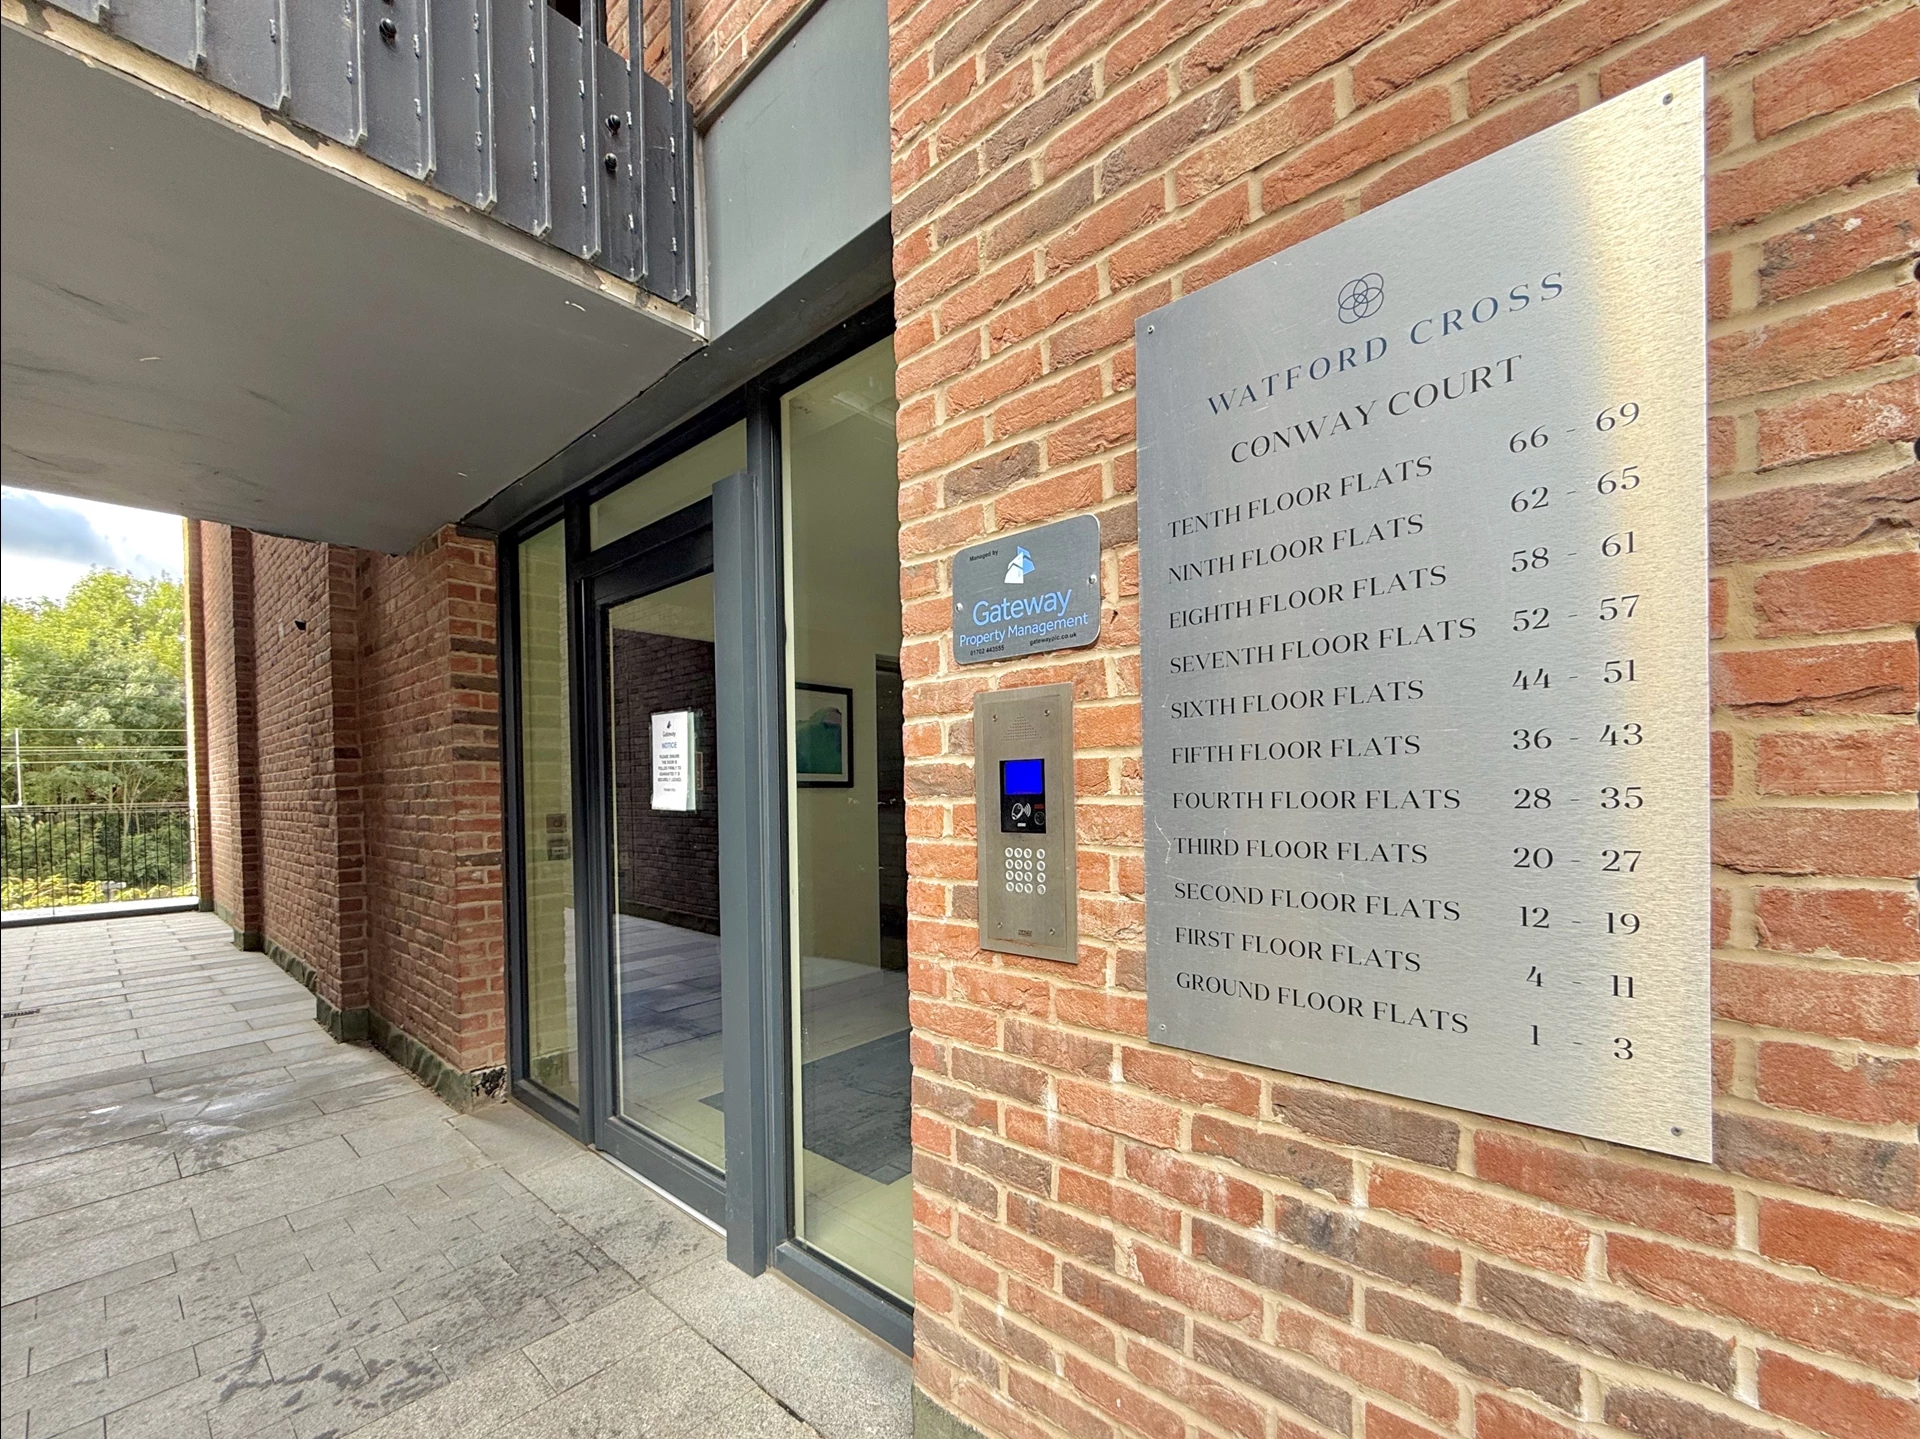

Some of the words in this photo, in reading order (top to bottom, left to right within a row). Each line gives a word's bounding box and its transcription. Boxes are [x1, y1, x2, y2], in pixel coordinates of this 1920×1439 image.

[1208, 337, 1388, 416] WATFORD
[1410, 272, 1563, 345] CROSS
[1231, 400, 1378, 464] CONWAY
[1389, 355, 1523, 416] COURT
[1168, 504, 1241, 539] TENTH
[1248, 482, 1333, 520] FLOOR
[1341, 456, 1433, 497] FLATS
[1510, 425, 1549, 454] 66
[1596, 402, 1640, 432] 69
[969, 551, 991, 562] Managed
[1169, 554, 1235, 584] NINTH
[1241, 536, 1325, 570] FLOOR
[1332, 514, 1424, 551] FLATS
[1510, 487, 1550, 513] 62
[1597, 465, 1641, 496] 65
[972, 589, 1072, 626] Gateway
[1169, 599, 1253, 630] EIGHTH
[1259, 584, 1345, 615] FLOOR
[1353, 566, 1447, 600] FLATS
[1511, 547, 1550, 573] 58
[1602, 531, 1638, 558] 61
[960, 629, 1006, 647] Property
[1008, 612, 1088, 638] Management
[1170, 644, 1275, 674] SEVENTH
[1281, 633, 1370, 662] FLOOR
[1379, 618, 1477, 649] FLATS
[1512, 608, 1550, 632] 52
[1599, 595, 1641, 622] 57
[1170, 697, 1236, 720] SIXTH
[1242, 690, 1326, 714] FLOOR
[1333, 680, 1425, 707] FLATS
[1512, 668, 1552, 691] 44
[1603, 659, 1638, 685] 51
[1173, 745, 1234, 765] FIFTH
[1240, 741, 1323, 762] FLOOR
[1330, 735, 1421, 758] FLATS
[1512, 728, 1553, 751] 36
[1599, 723, 1644, 747] 43
[1173, 791, 1264, 810] FOURTH
[1270, 790, 1358, 810] FLOOR
[1366, 789, 1461, 810] FLATS
[1513, 788, 1552, 810] 28
[1600, 787, 1644, 810] 35
[1173, 837, 1240, 857] THIRD
[1246, 840, 1330, 861] FLOOR
[1337, 842, 1428, 865] FLATS
[1512, 847, 1554, 870] 20
[1601, 850, 1643, 873] 27
[1174, 882, 1264, 906] SECOND
[1270, 888, 1359, 914] FLOOR
[1366, 895, 1461, 922] FLATS
[1518, 906, 1550, 929] 12
[1605, 912, 1641, 936] 19
[1175, 927, 1236, 950] FIRST
[1241, 934, 1324, 962] FLOOR
[1331, 944, 1421, 973] FLATS
[1526, 966, 1545, 988] 4
[1610, 975, 1635, 999] 11
[1176, 972, 1271, 1002] GROUND
[1278, 986, 1365, 1018] FLOOR
[1373, 1001, 1469, 1034] FLATS
[1530, 1025, 1541, 1046] 1
[1614, 1037, 1634, 1060] 3
